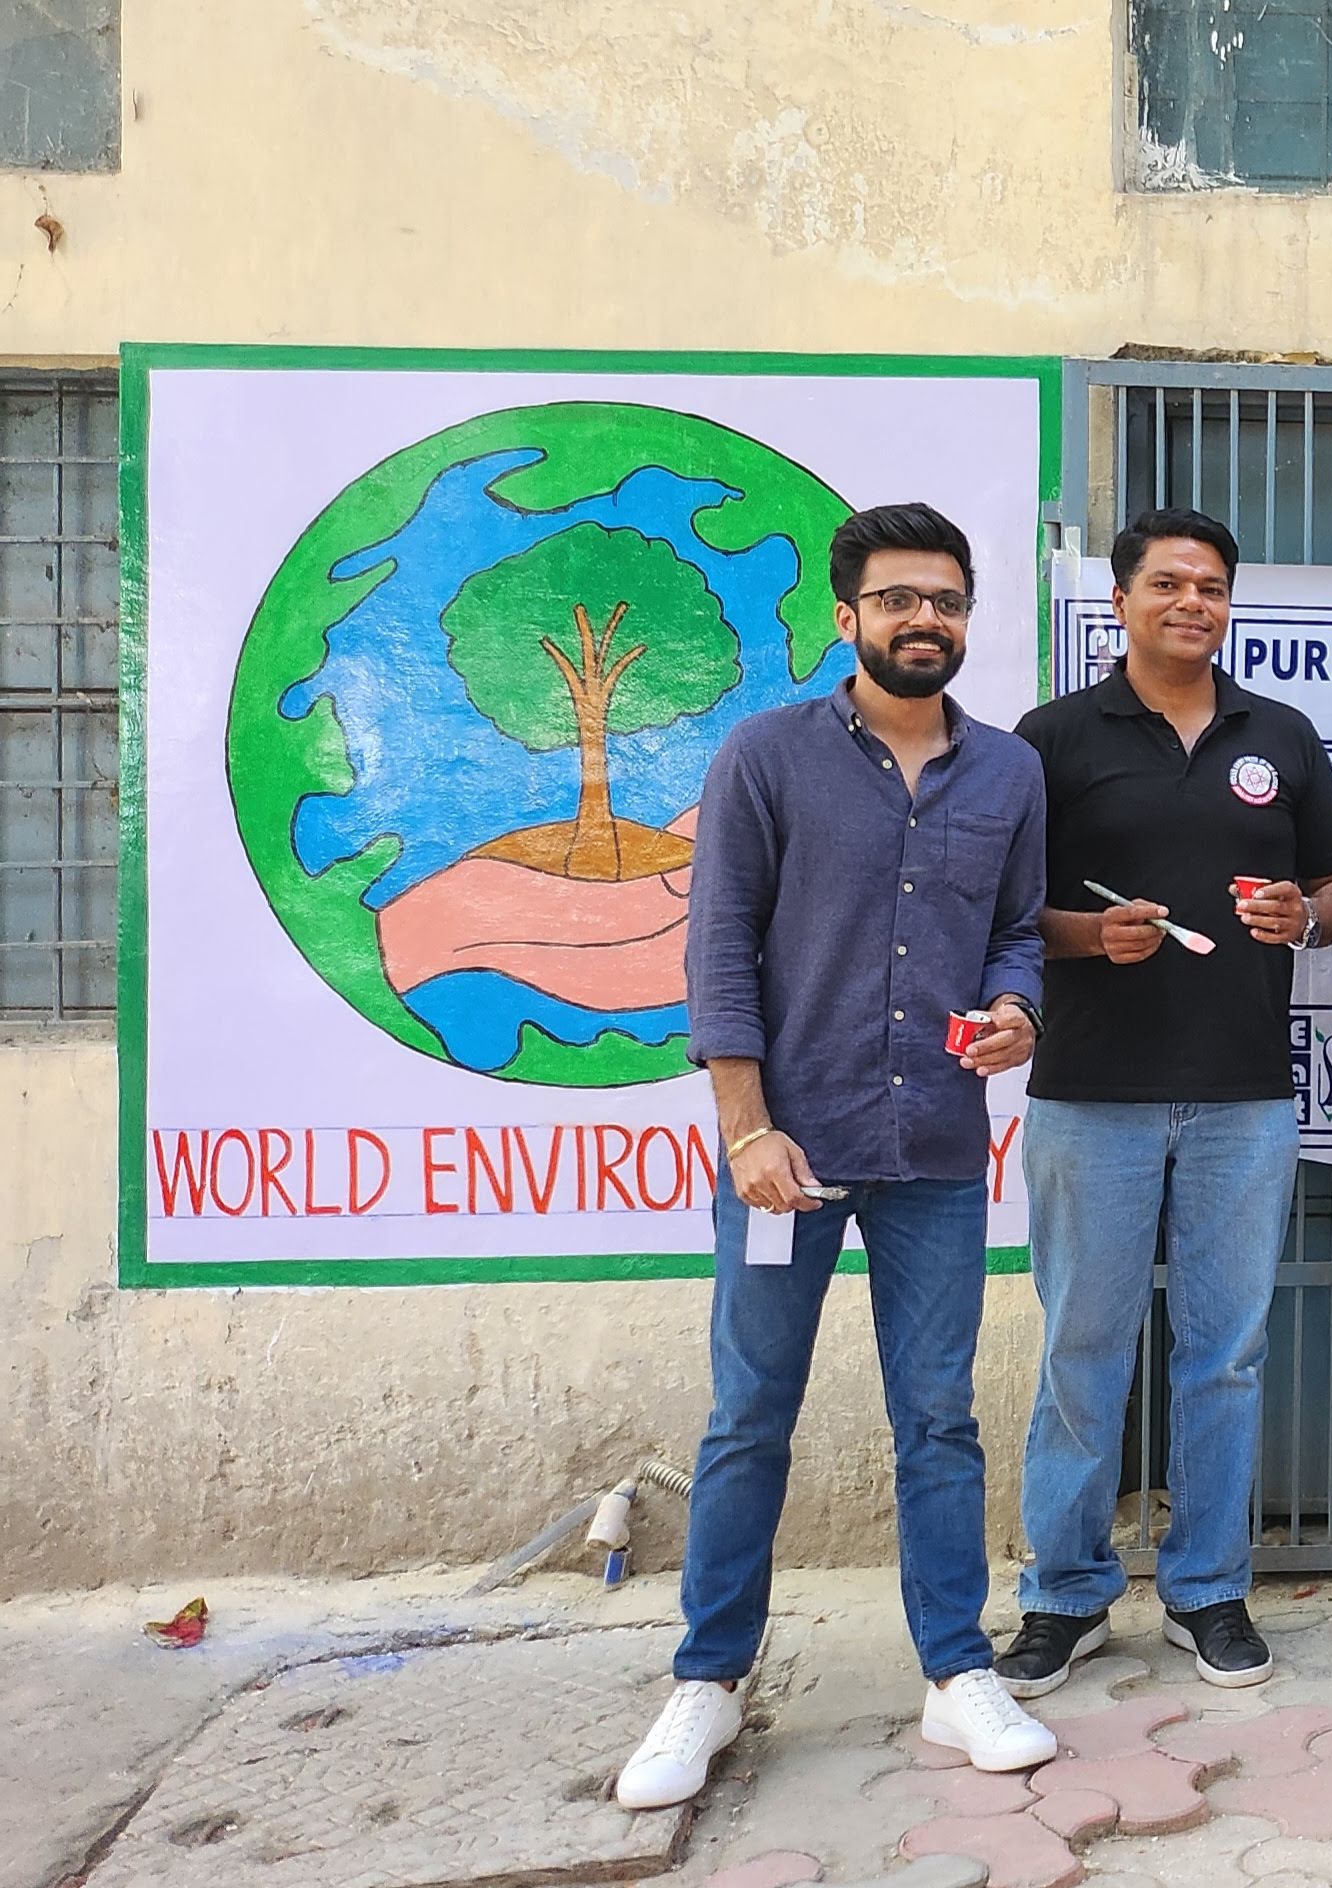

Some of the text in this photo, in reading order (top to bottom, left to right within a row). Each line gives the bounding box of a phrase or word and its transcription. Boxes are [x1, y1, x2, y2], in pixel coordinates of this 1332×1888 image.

[1088, 628, 1129, 657] PU
[152, 1124, 718, 1217] WORLD ENVIRON
